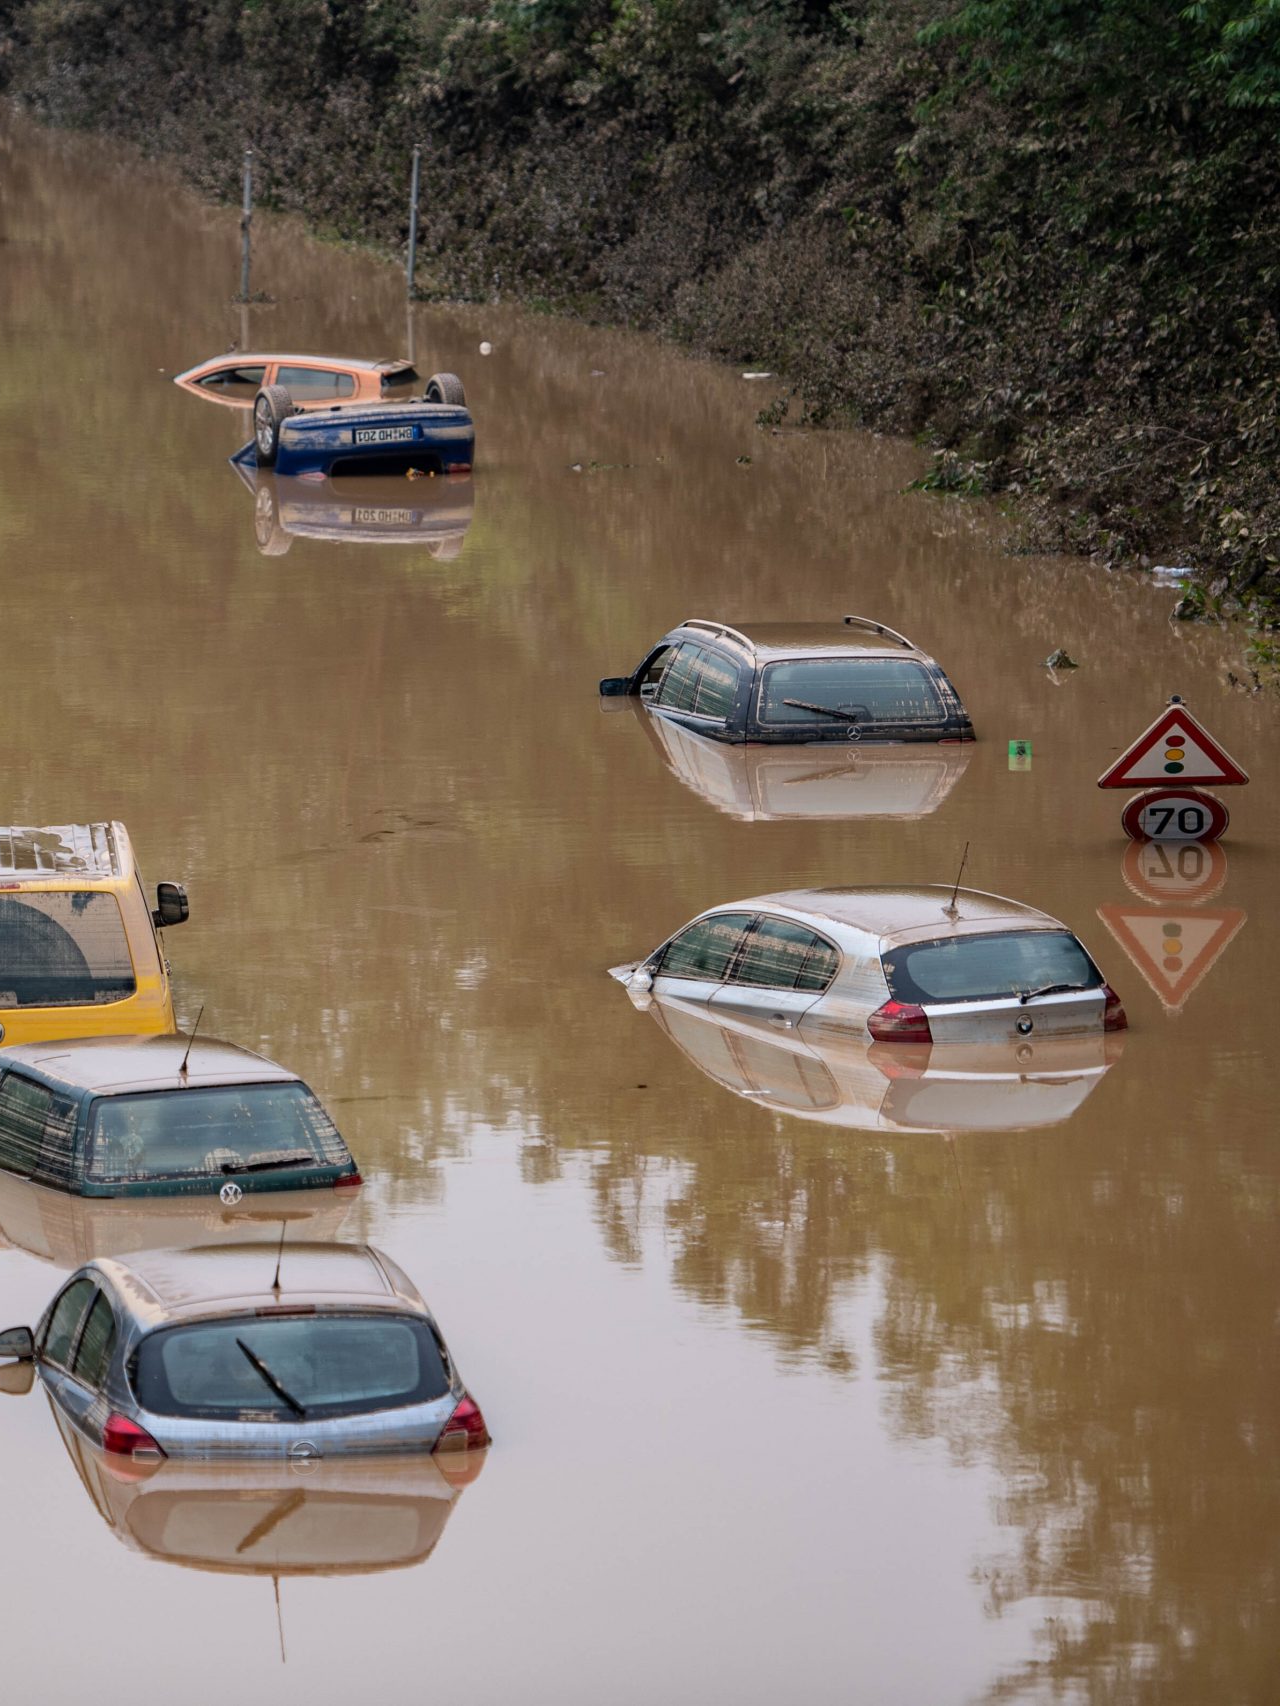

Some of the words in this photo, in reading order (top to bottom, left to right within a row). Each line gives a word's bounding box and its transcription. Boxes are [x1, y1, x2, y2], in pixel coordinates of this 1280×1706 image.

[357, 430, 377, 442] 201
[378, 428, 393, 441] HD
[1149, 807, 1204, 835] 70
